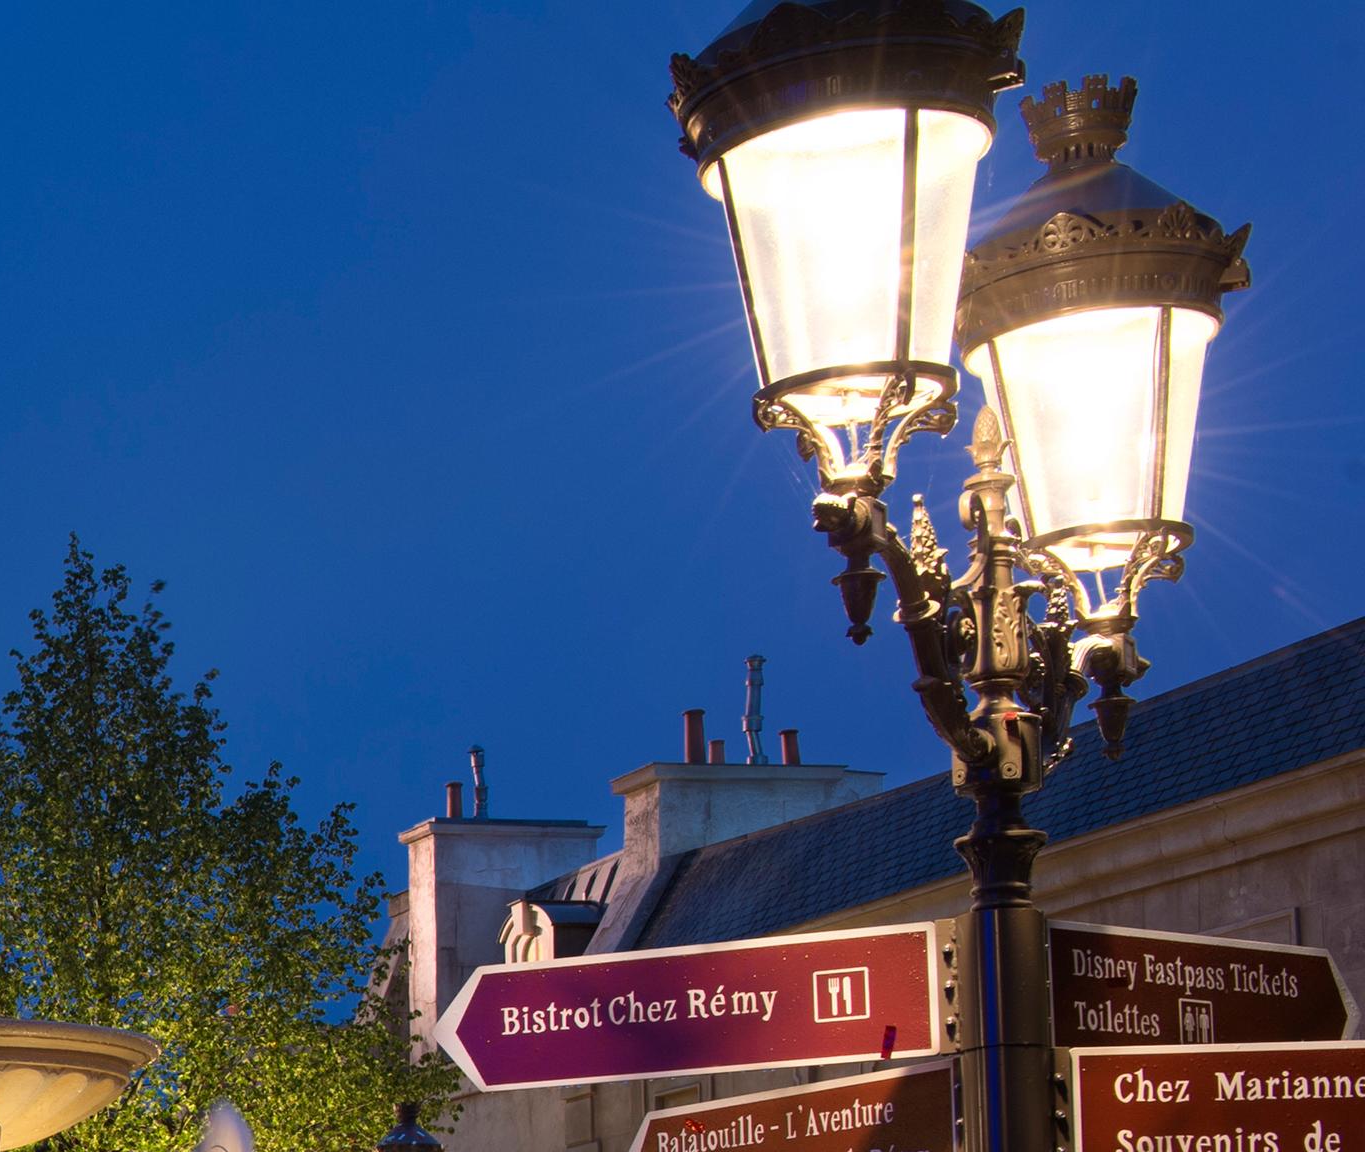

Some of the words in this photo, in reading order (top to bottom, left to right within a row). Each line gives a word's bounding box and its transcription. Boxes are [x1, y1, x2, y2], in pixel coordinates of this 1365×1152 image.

[1071, 948, 1138, 991] Disney
[1143, 953, 1226, 996] Fastpass
[1229, 962, 1300, 999] Tickets
[500, 996, 603, 1036] Bistrot
[608, 990, 678, 1026] Chez
[686, 983, 779, 1022] Rémy
[1073, 1000, 1161, 1038] Toilettes
[1113, 1068, 1190, 1103] Chez
[785, 1097, 895, 1140] L'Aventure
